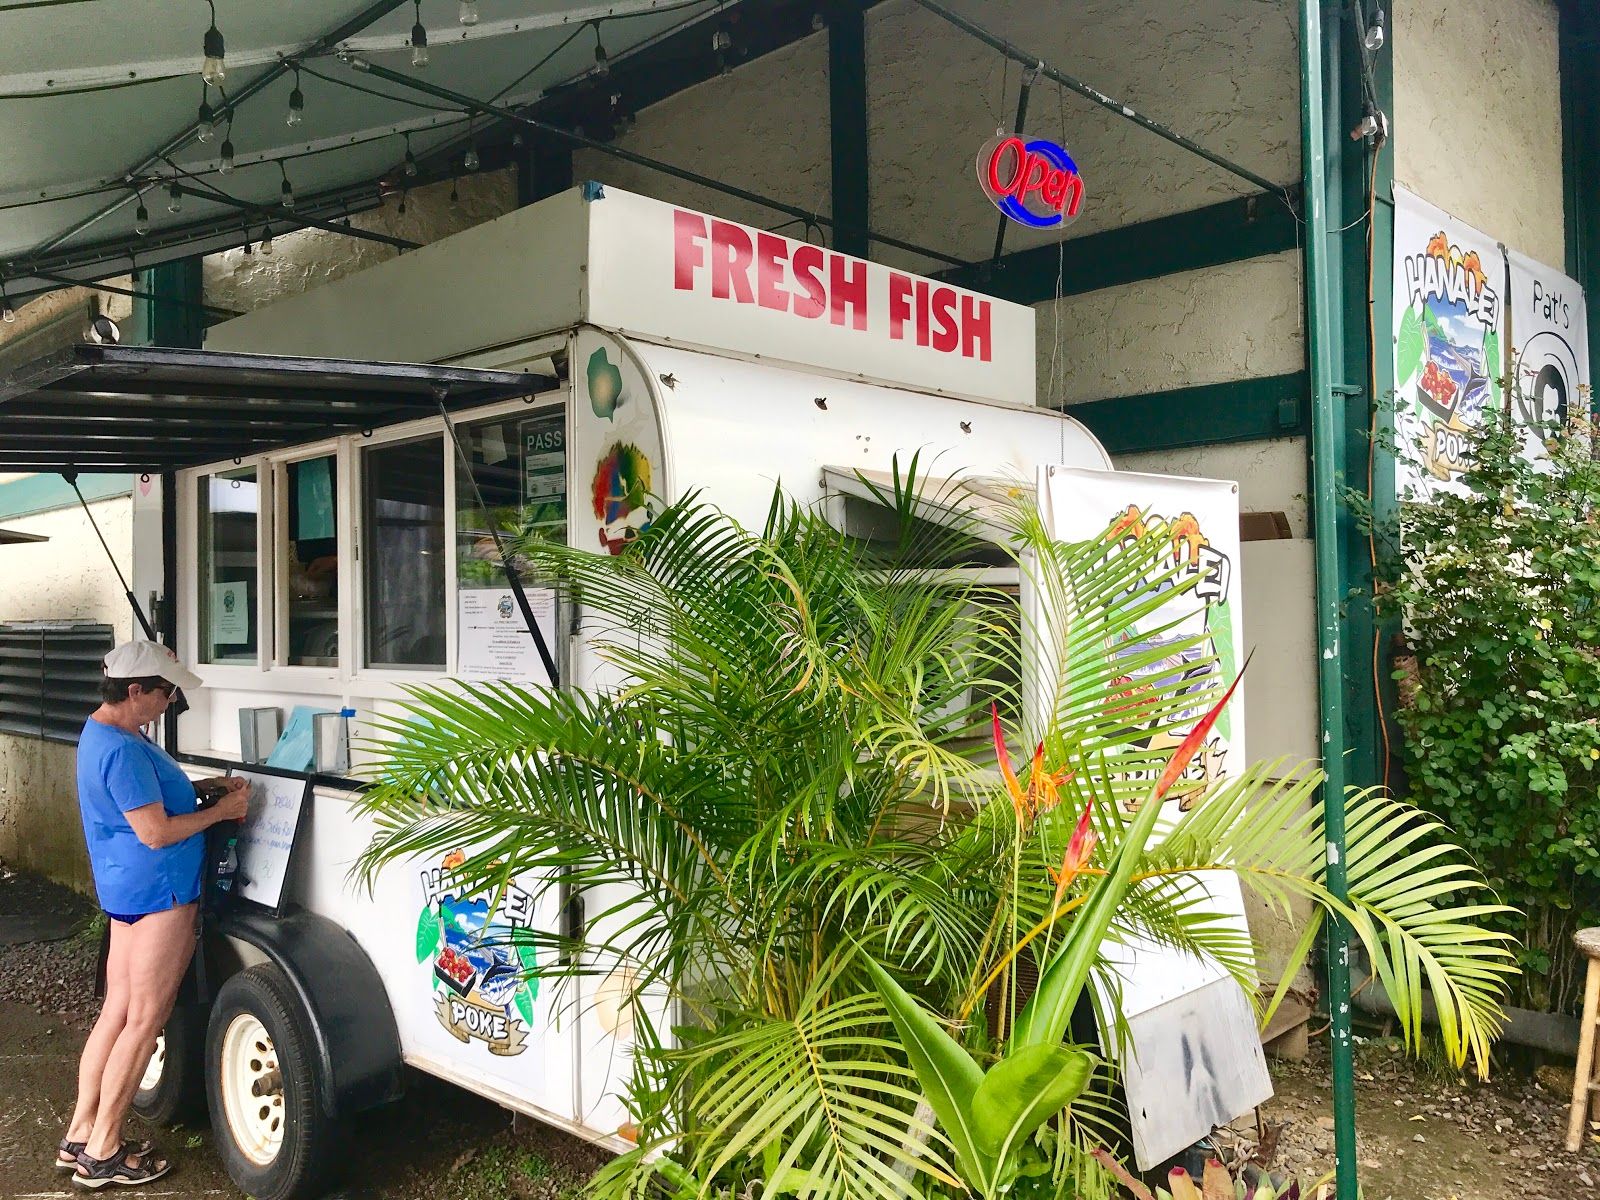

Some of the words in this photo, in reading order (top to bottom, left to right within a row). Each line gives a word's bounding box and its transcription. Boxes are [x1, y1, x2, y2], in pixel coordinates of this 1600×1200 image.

[988, 137, 1083, 217] Open
[674, 209, 868, 331] FRESH
[889, 272, 992, 362] FISH
[1405, 253, 1500, 335] HANALEI
[1533, 279, 1570, 330] Pat's
[527, 430, 562, 451] PASS
[450, 1000, 509, 1040] POKE
